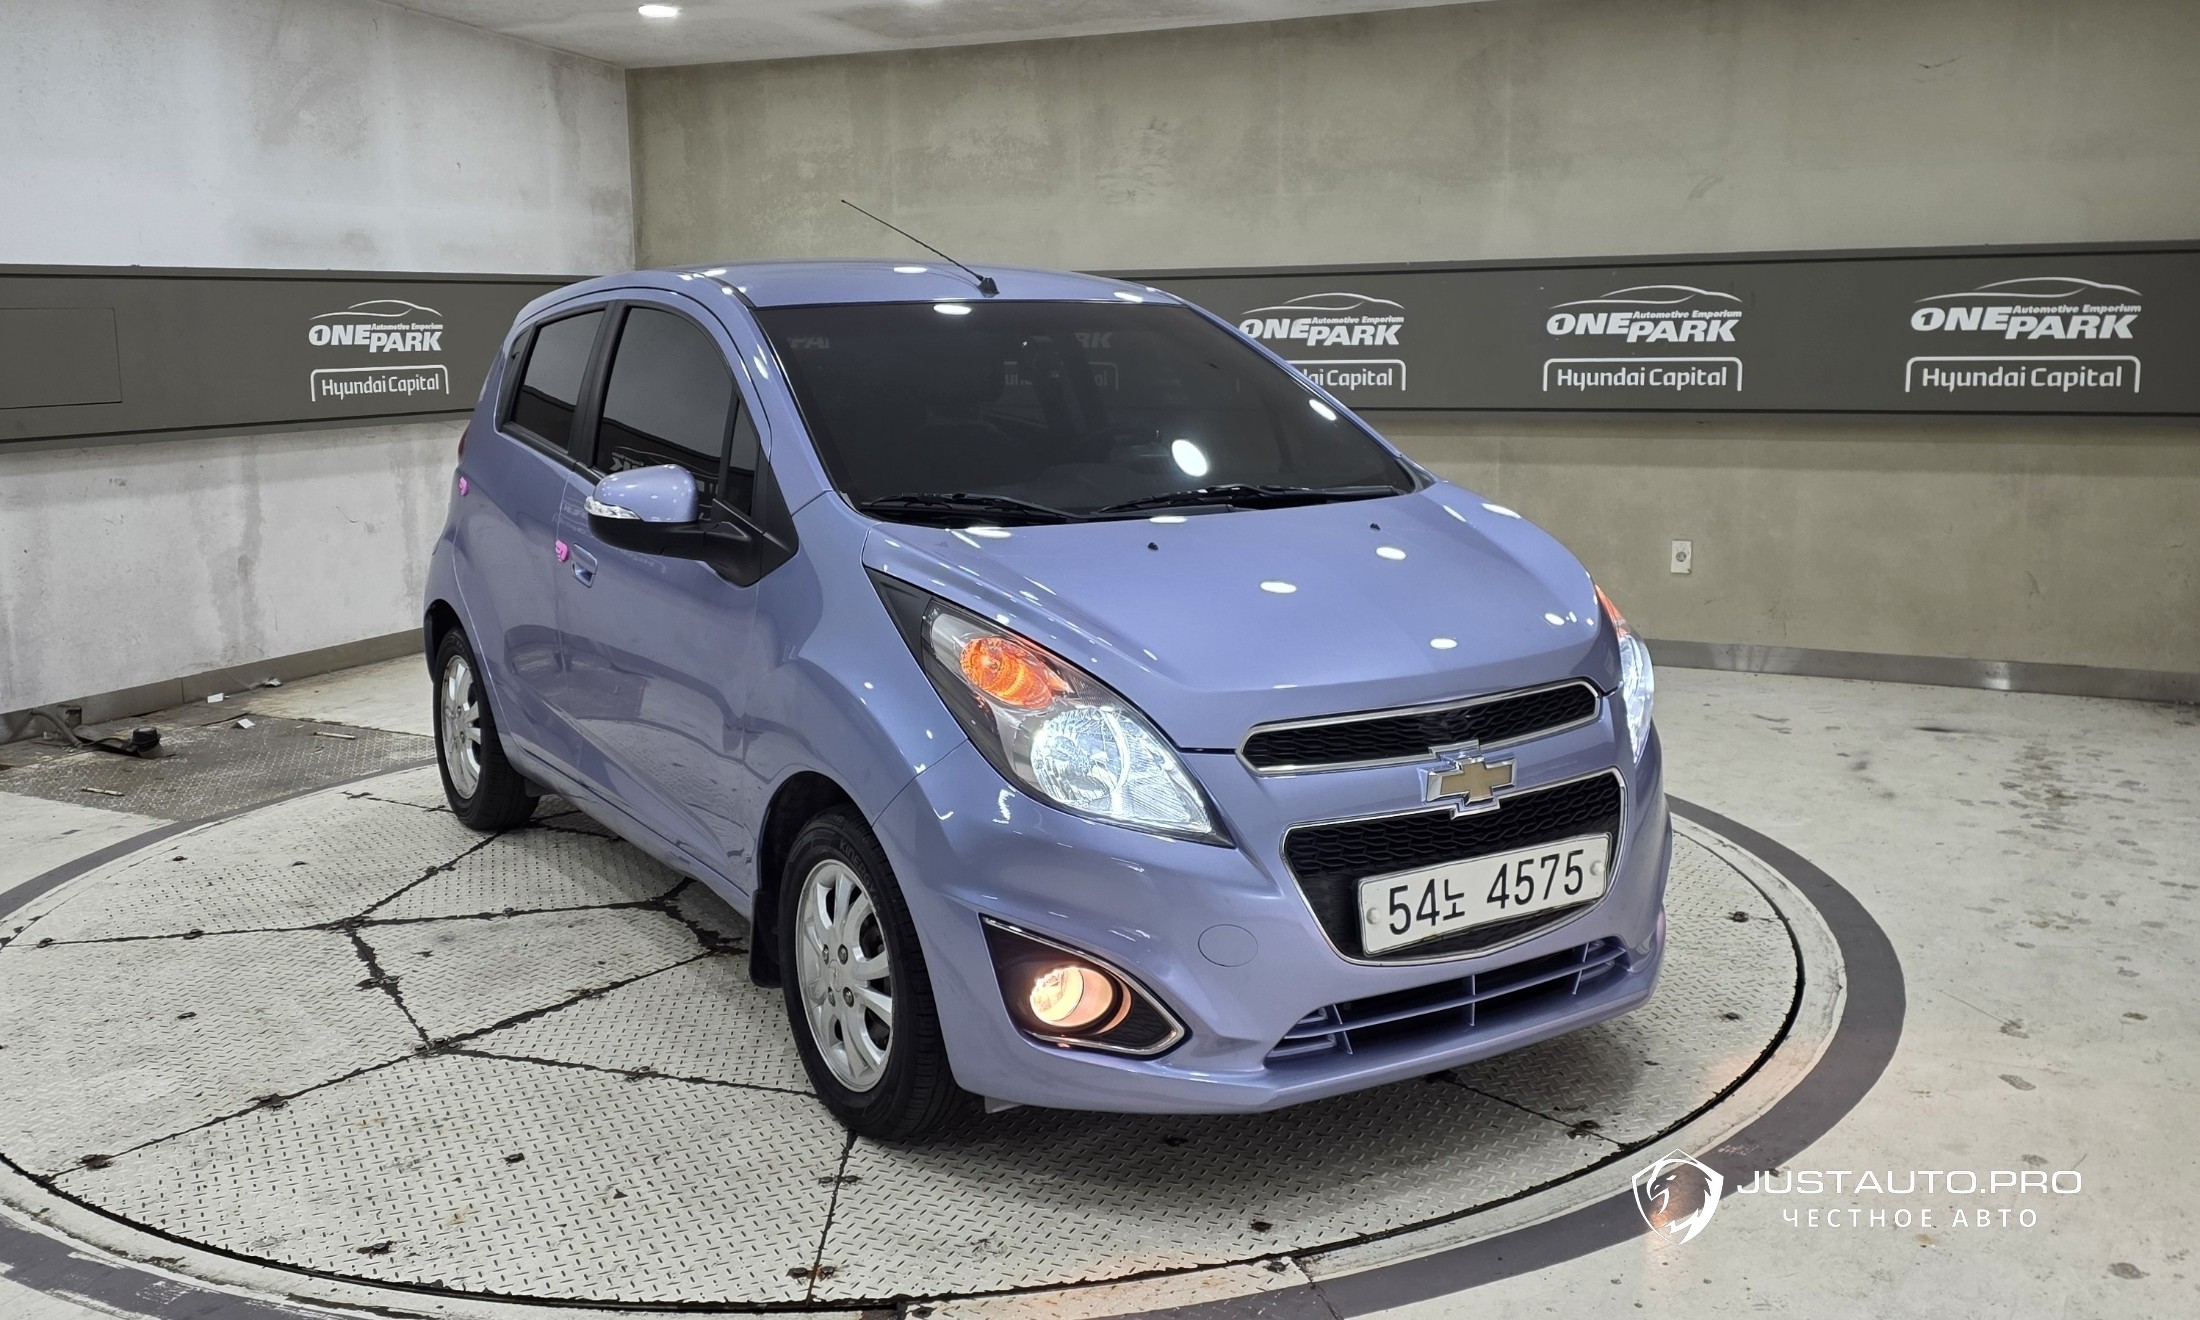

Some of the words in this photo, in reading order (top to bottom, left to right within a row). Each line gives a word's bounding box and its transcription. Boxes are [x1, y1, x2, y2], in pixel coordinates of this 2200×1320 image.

[1311, 316, 1360, 324] Automotive
[1361, 315, 1404, 324] Emporium
[1632, 310, 1689, 319] Automotive
[1692, 309, 1743, 319] Emporium
[2012, 304, 2080, 314] Automotive
[2082, 303, 2142, 315] Emporium
[371, 323, 410, 331] Automotive
[411, 322, 443, 331] Emporium
[321, 376, 387, 400] Hyundai
[388, 373, 440, 396] Capital
[1326, 368, 1393, 391] Capital
[1557, 367, 1645, 391] Hyundai
[1649, 366, 1727, 391] Capital
[1922, 366, 2026, 392] Hyundai
[2030, 366, 2122, 392] Capital
[840, 840, 876, 892] KINERGY
[1388, 878, 1465, 936] 54노
[1486, 848, 1584, 909] 4575
